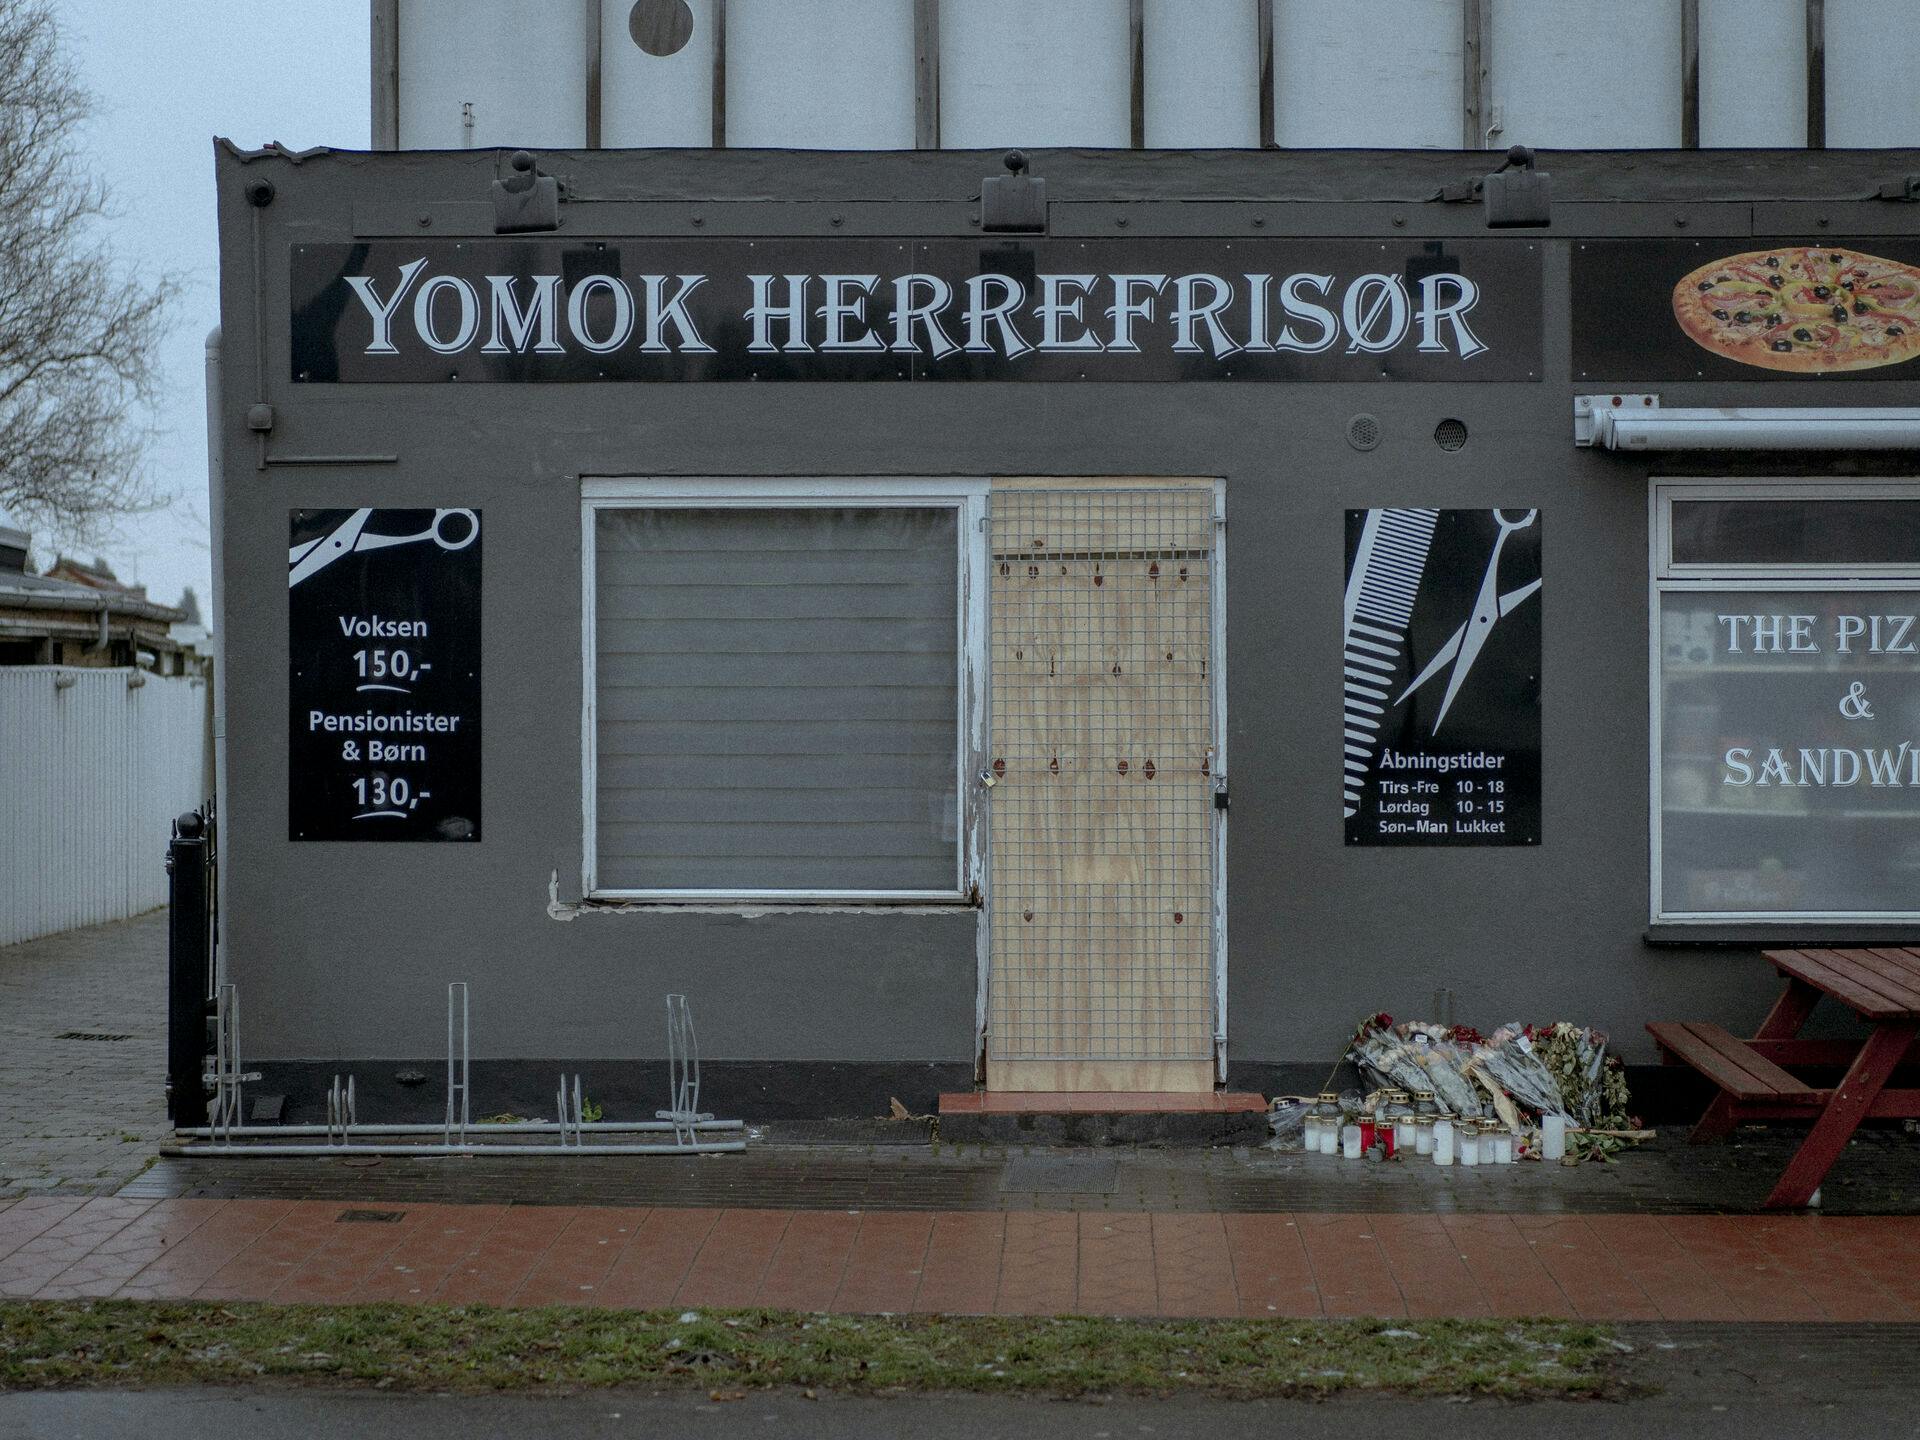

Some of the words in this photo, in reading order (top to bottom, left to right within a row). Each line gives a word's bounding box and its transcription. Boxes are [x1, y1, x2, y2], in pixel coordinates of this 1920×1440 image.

[343, 257, 718, 355] YOMOK
[743, 273, 1490, 360] HERREFRISØR
[339, 615, 428, 637] Voksen
[1718, 614, 1821, 654] THE
[1835, 614, 1920, 654] PIZ
[353, 650, 431, 681] 150,-
[1839, 681, 1875, 720] &
[309, 710, 460, 732] Pensionister
[342, 740, 360, 761] &
[368, 740, 426, 762] Børn
[1379, 748, 1505, 773] Åbningstider
[352, 777, 431, 809] 130,-
[1379, 800, 1430, 816] Lørdag
[1456, 820, 1505, 833] Lukket
